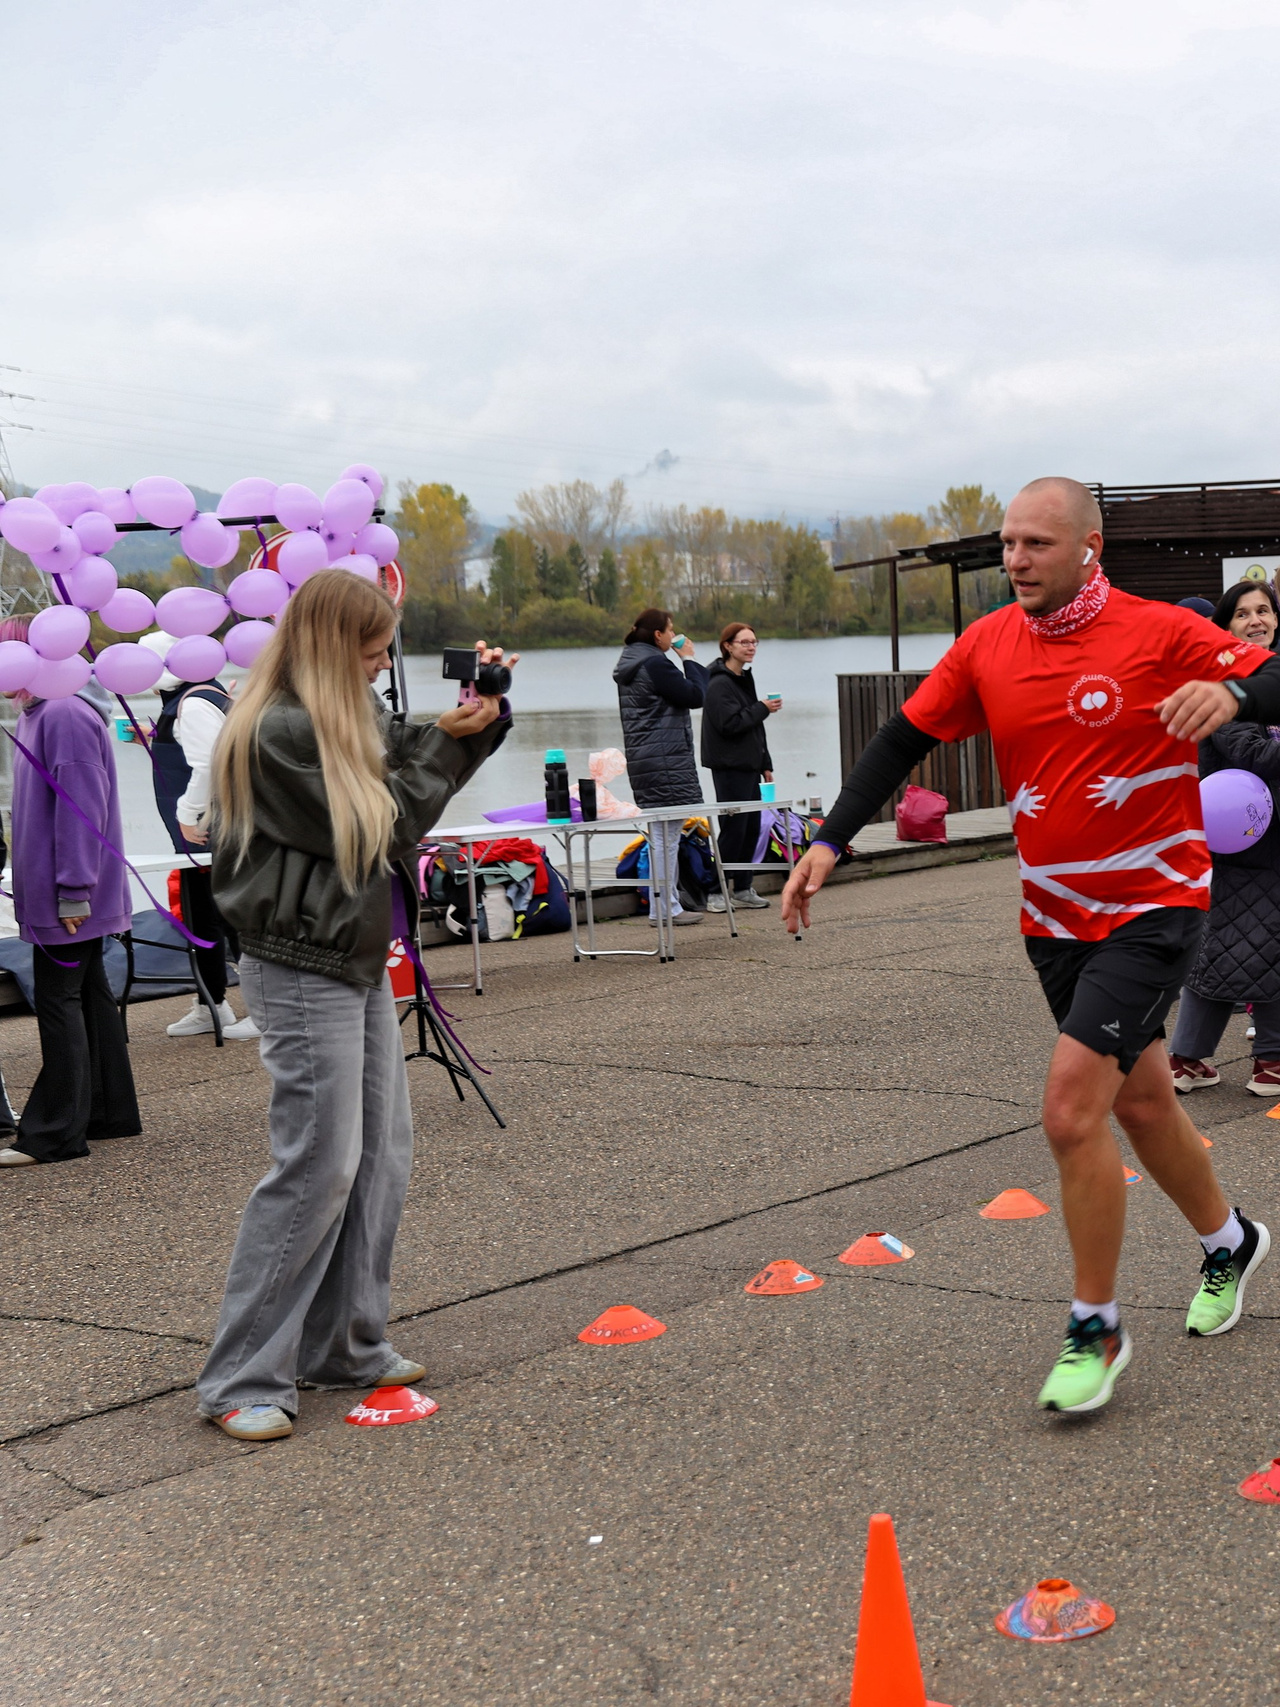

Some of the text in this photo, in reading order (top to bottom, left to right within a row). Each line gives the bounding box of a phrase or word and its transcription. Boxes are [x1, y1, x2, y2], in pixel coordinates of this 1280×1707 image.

[1067, 674, 1124, 728] сообщество доноров крови
[588, 1323, 654, 1339] ебоксар
